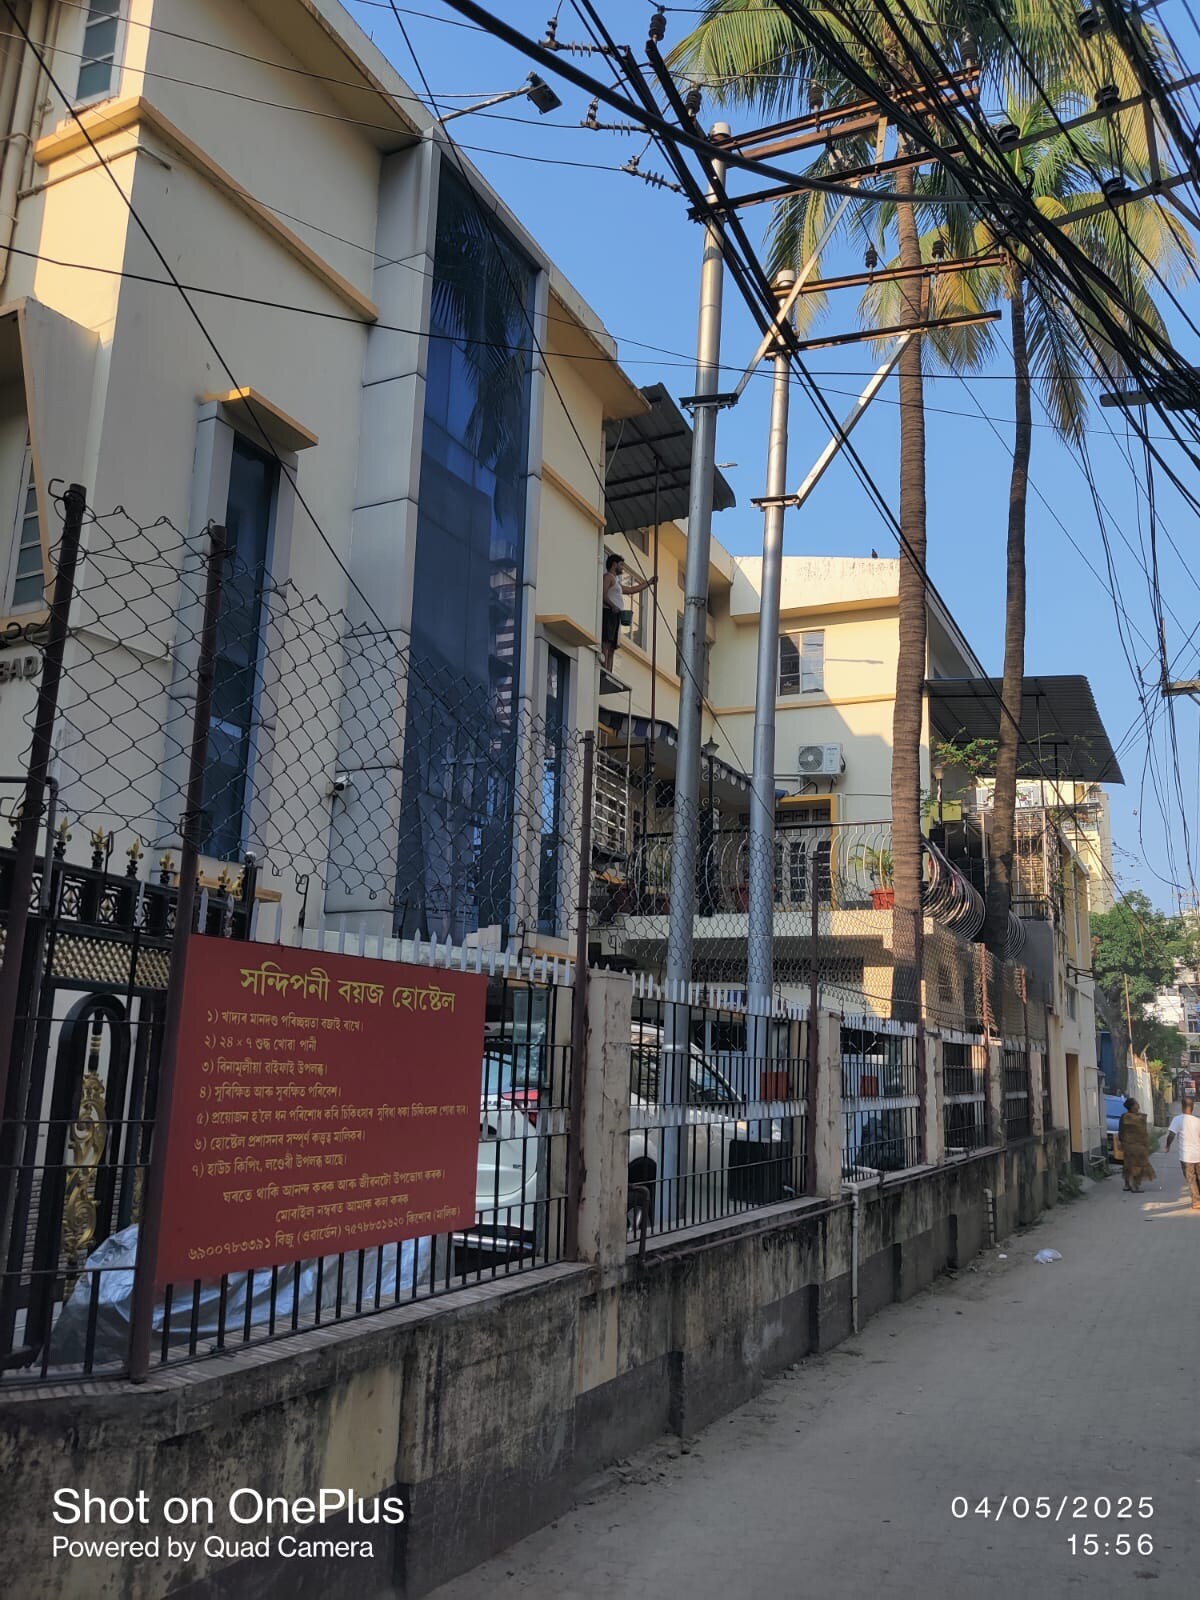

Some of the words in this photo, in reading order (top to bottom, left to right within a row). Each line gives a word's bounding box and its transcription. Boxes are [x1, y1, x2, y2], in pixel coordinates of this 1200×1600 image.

[240, 961, 330, 1001] সন্দিপনী
[337, 980, 384, 1006] বয়জ
[393, 984, 455, 1012] হোষ্টেল
[220, 1037, 233, 1048] ২৪
[300, 1036, 316, 1051] পানী
[212, 1112, 249, 1124] প্ৰয়োজন
[210, 1134, 246, 1150] হোষ্টেল
